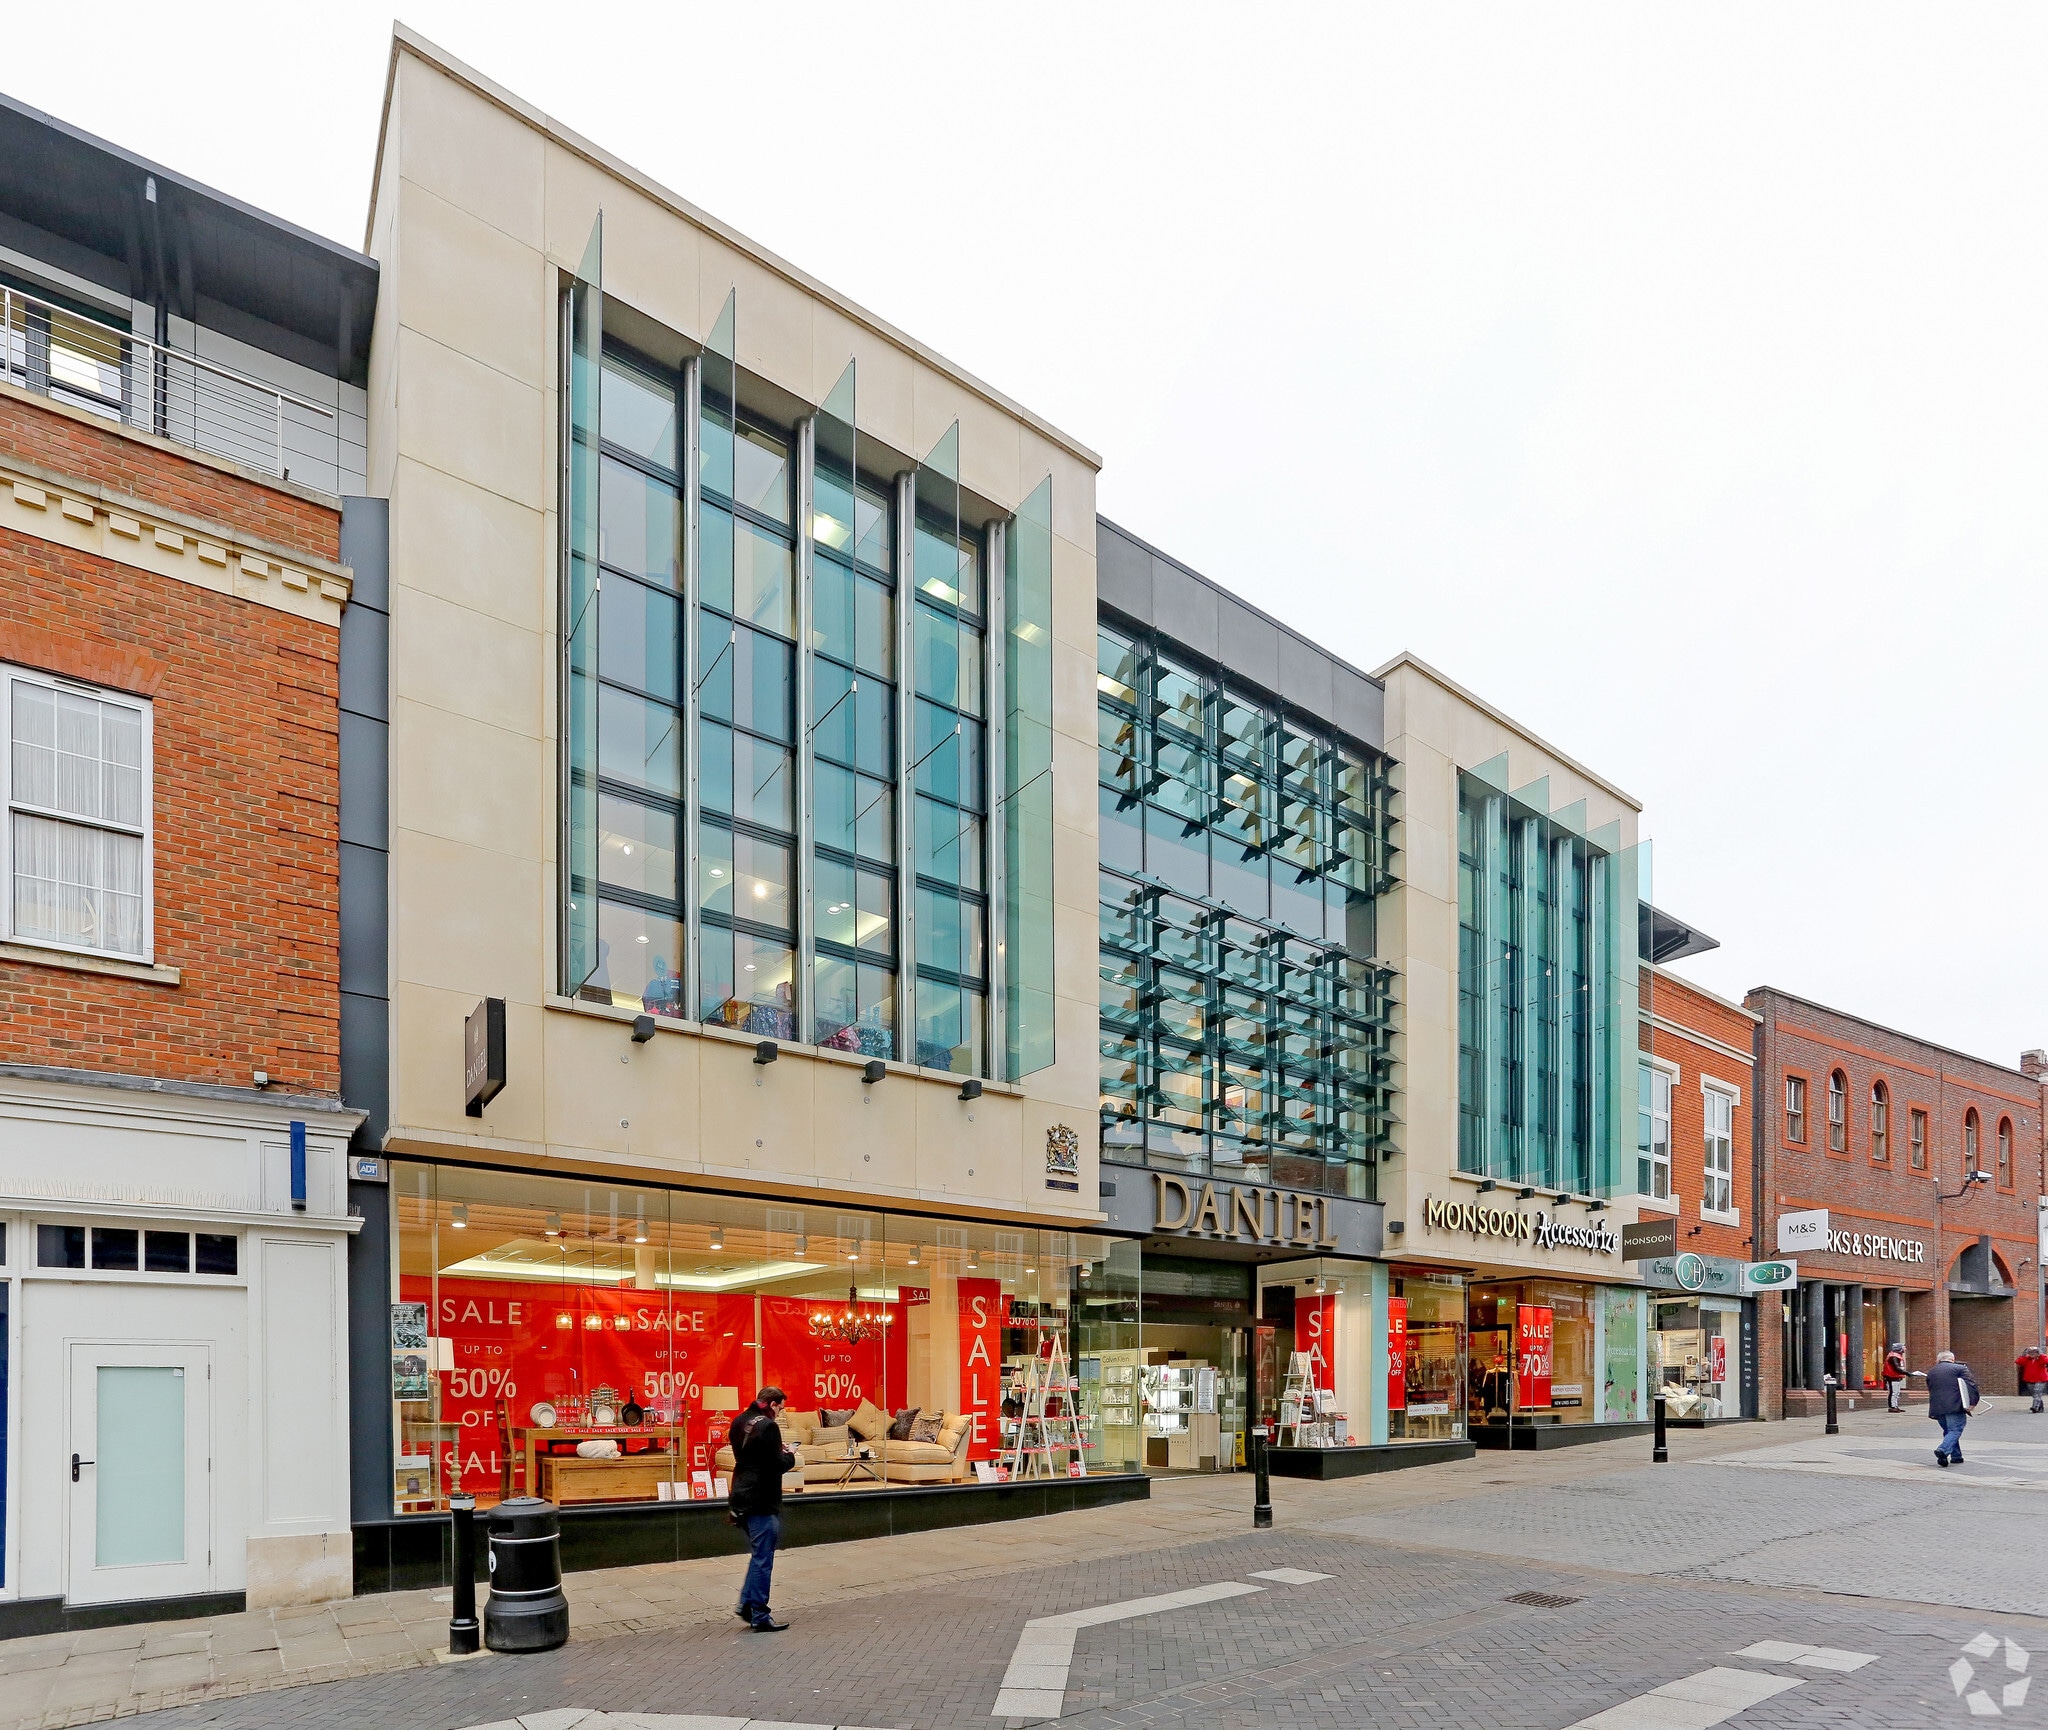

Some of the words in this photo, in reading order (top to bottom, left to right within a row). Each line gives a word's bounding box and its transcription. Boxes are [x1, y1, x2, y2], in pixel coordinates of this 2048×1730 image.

[466, 1048, 488, 1089] DANIEL
[360, 1165, 377, 1174] ADT
[1153, 1173, 1339, 1248] DANIEL
[1425, 1198, 1530, 1240] MONSOON
[1535, 1210, 1619, 1254] Accessorize
[1788, 1222, 1816, 1235] M&S
[1624, 1234, 1672, 1246] MONSOON
[1823, 1228, 1850, 1255] RKS
[1852, 1232, 1863, 1256] &
[1863, 1234, 1924, 1263] SPENCER
[1753, 1266, 1786, 1281] C&H
[441, 1298, 523, 1326] SALE
[637, 1307, 705, 1332] SALE
[1388, 1318, 1404, 1334] LE
[1522, 1324, 1550, 1338] SALE
[464, 1345, 480, 1355] UP
[485, 1345, 503, 1355] TO
[655, 1350, 669, 1360] UP
[673, 1350, 688, 1360] TO
[823, 1354, 836, 1363] UP
[839, 1354, 852, 1363] TO
[1102, 1355, 1117, 1363] Calvin
[1117, 1355, 1130, 1363] Klein
[967, 1295, 991, 1444] SALE
[1522, 1354, 1549, 1376] 70%
[450, 1368, 518, 1399] 50%
[644, 1371, 700, 1399] 50%
[814, 1373, 862, 1399] 50%
